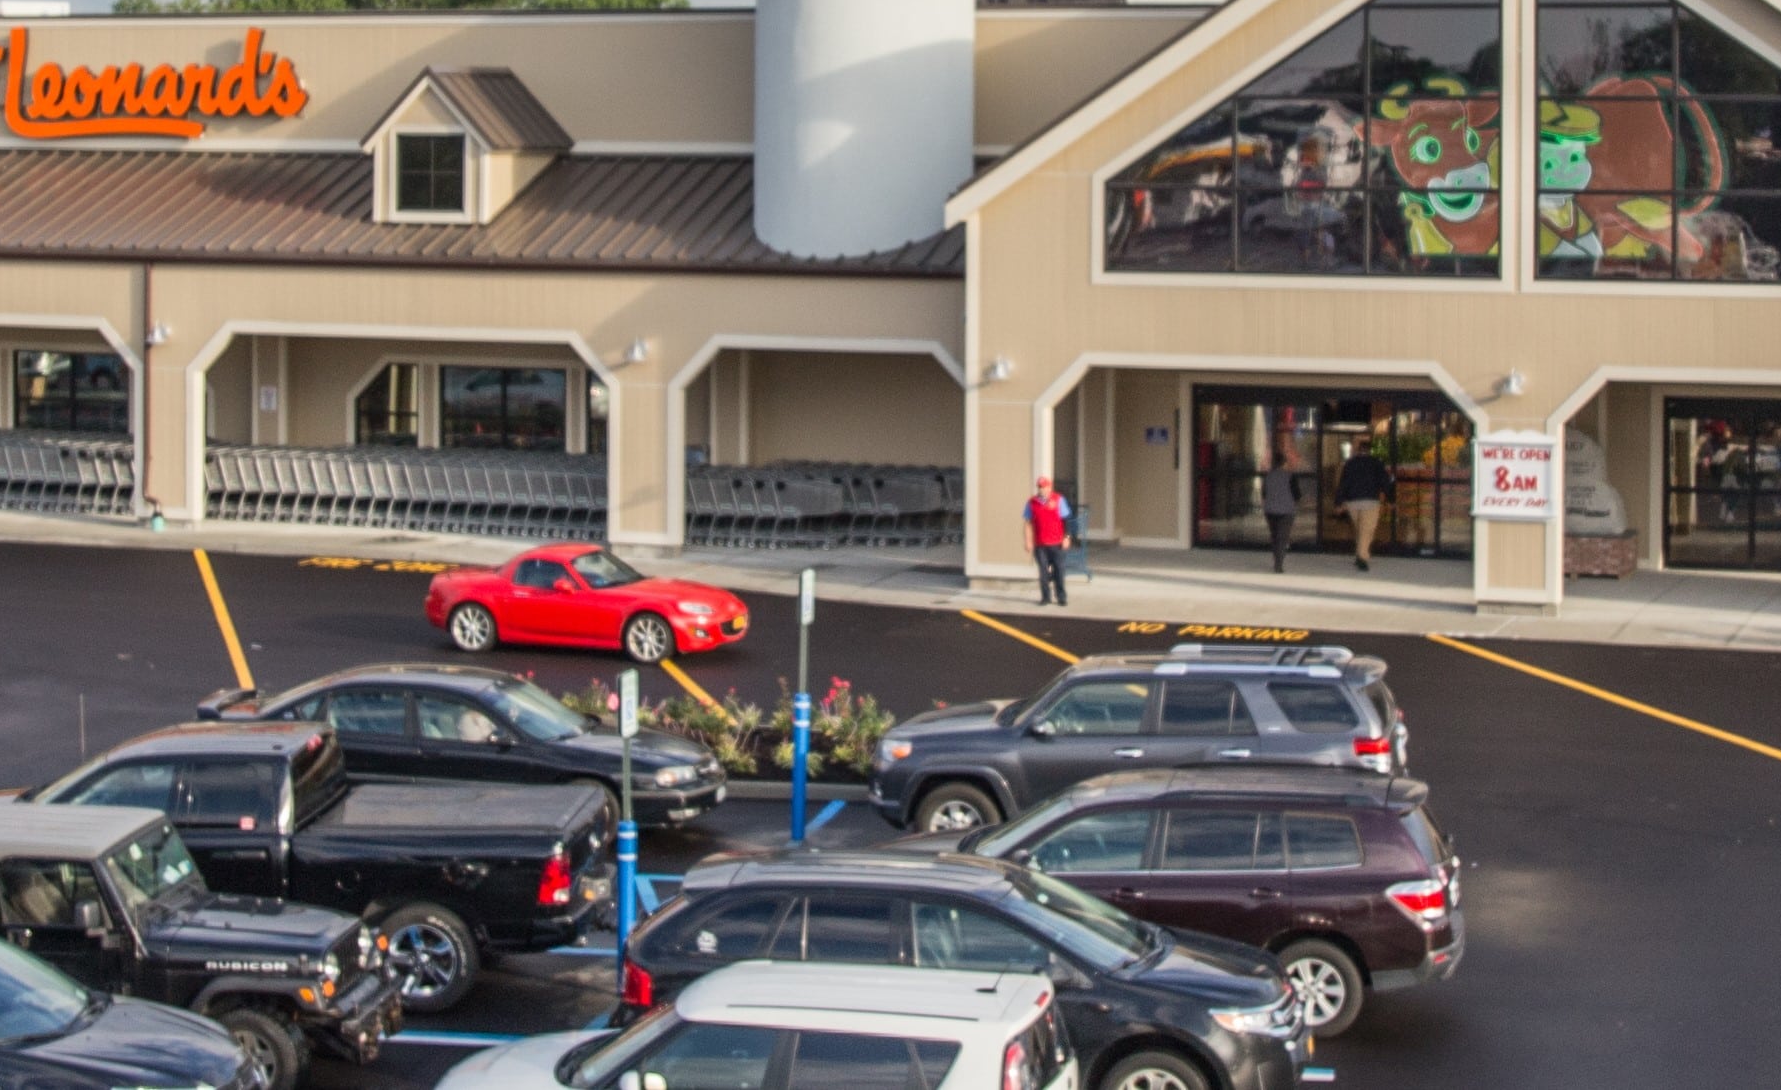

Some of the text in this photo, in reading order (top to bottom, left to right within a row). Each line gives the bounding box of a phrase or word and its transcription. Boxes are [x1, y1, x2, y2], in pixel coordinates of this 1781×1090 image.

[3, 25, 308, 139] Leonard's
[1482, 447, 1551, 462] WE'RE OPEN
[1493, 466, 1538, 492] 8 AM
[1482, 496, 1548, 508] EVERY DAY
[1117, 621, 1310, 642] NO PARKING
[205, 961, 289, 972] RUBICON
